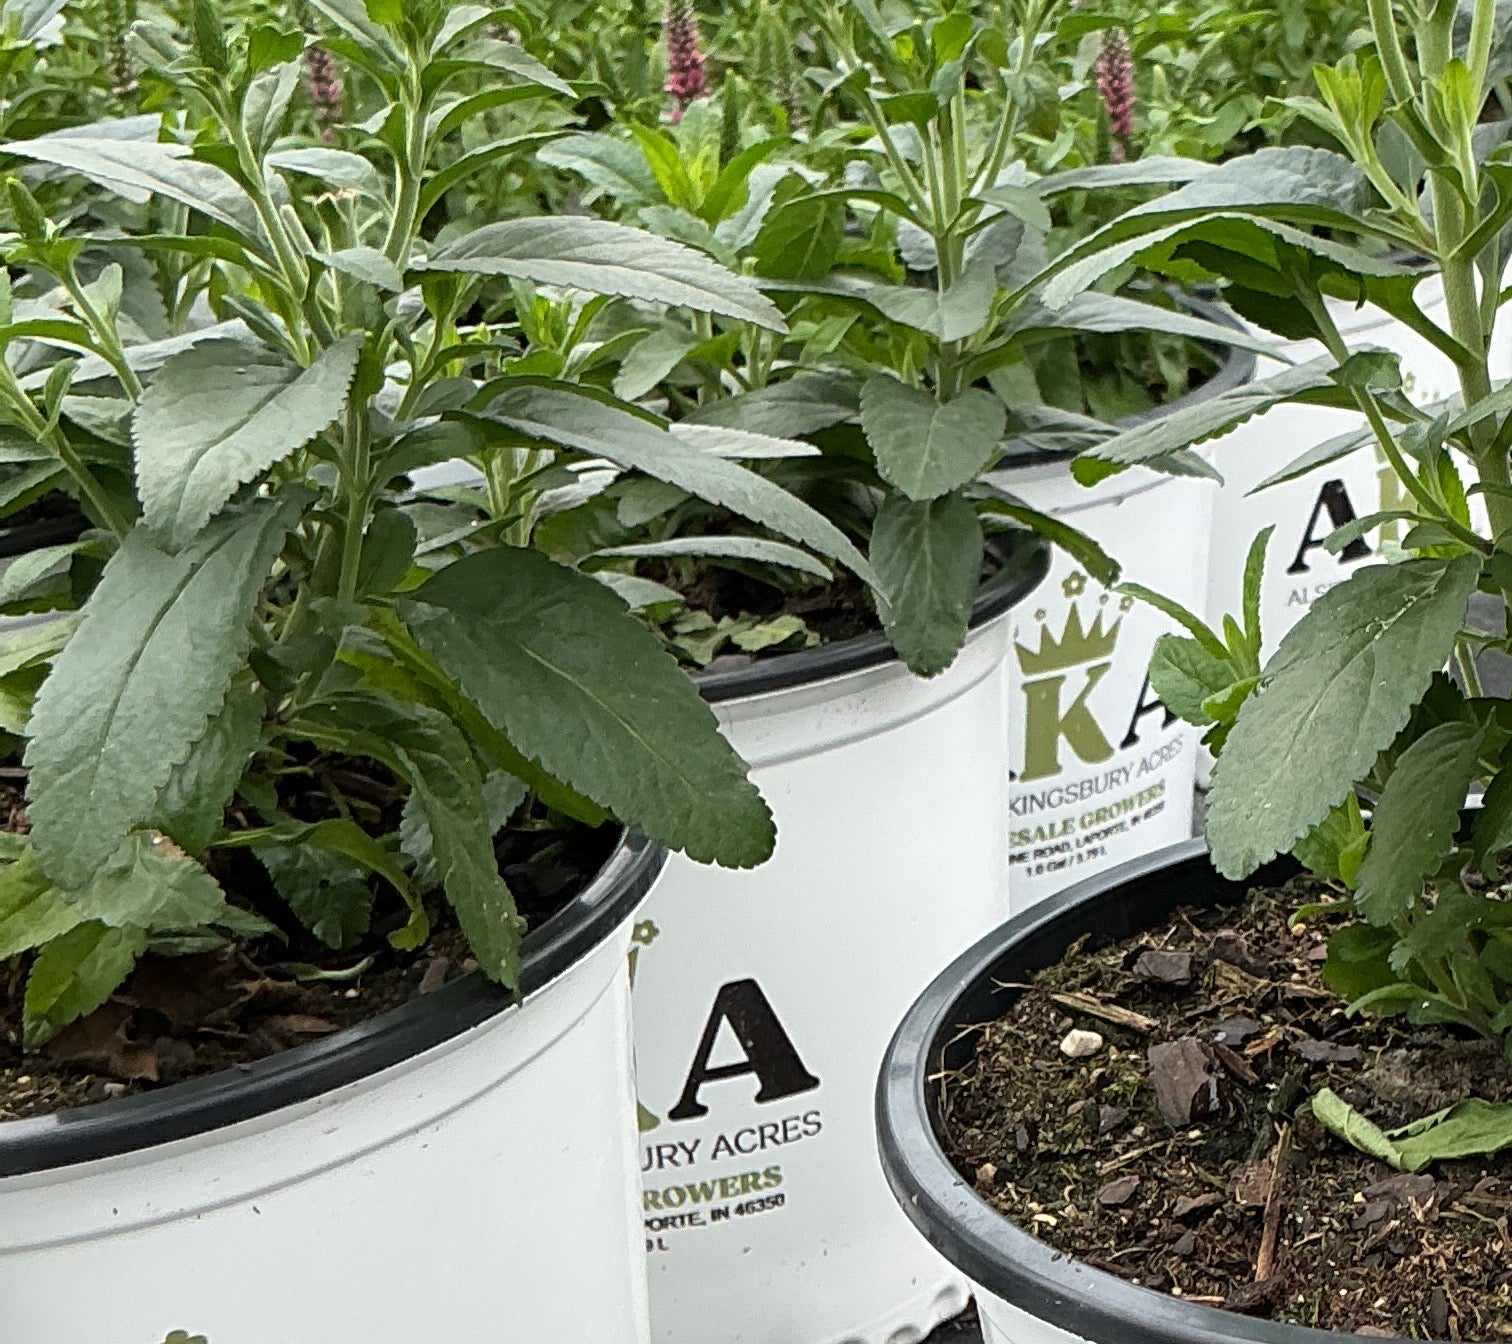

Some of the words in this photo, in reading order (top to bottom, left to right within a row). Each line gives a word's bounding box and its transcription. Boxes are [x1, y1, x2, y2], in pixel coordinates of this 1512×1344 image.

[711, 1110, 822, 1160] ACRES
[644, 1166, 783, 1211] ROWERS
[711, 1206, 729, 1223] IN
[734, 1193, 786, 1216] 46350
